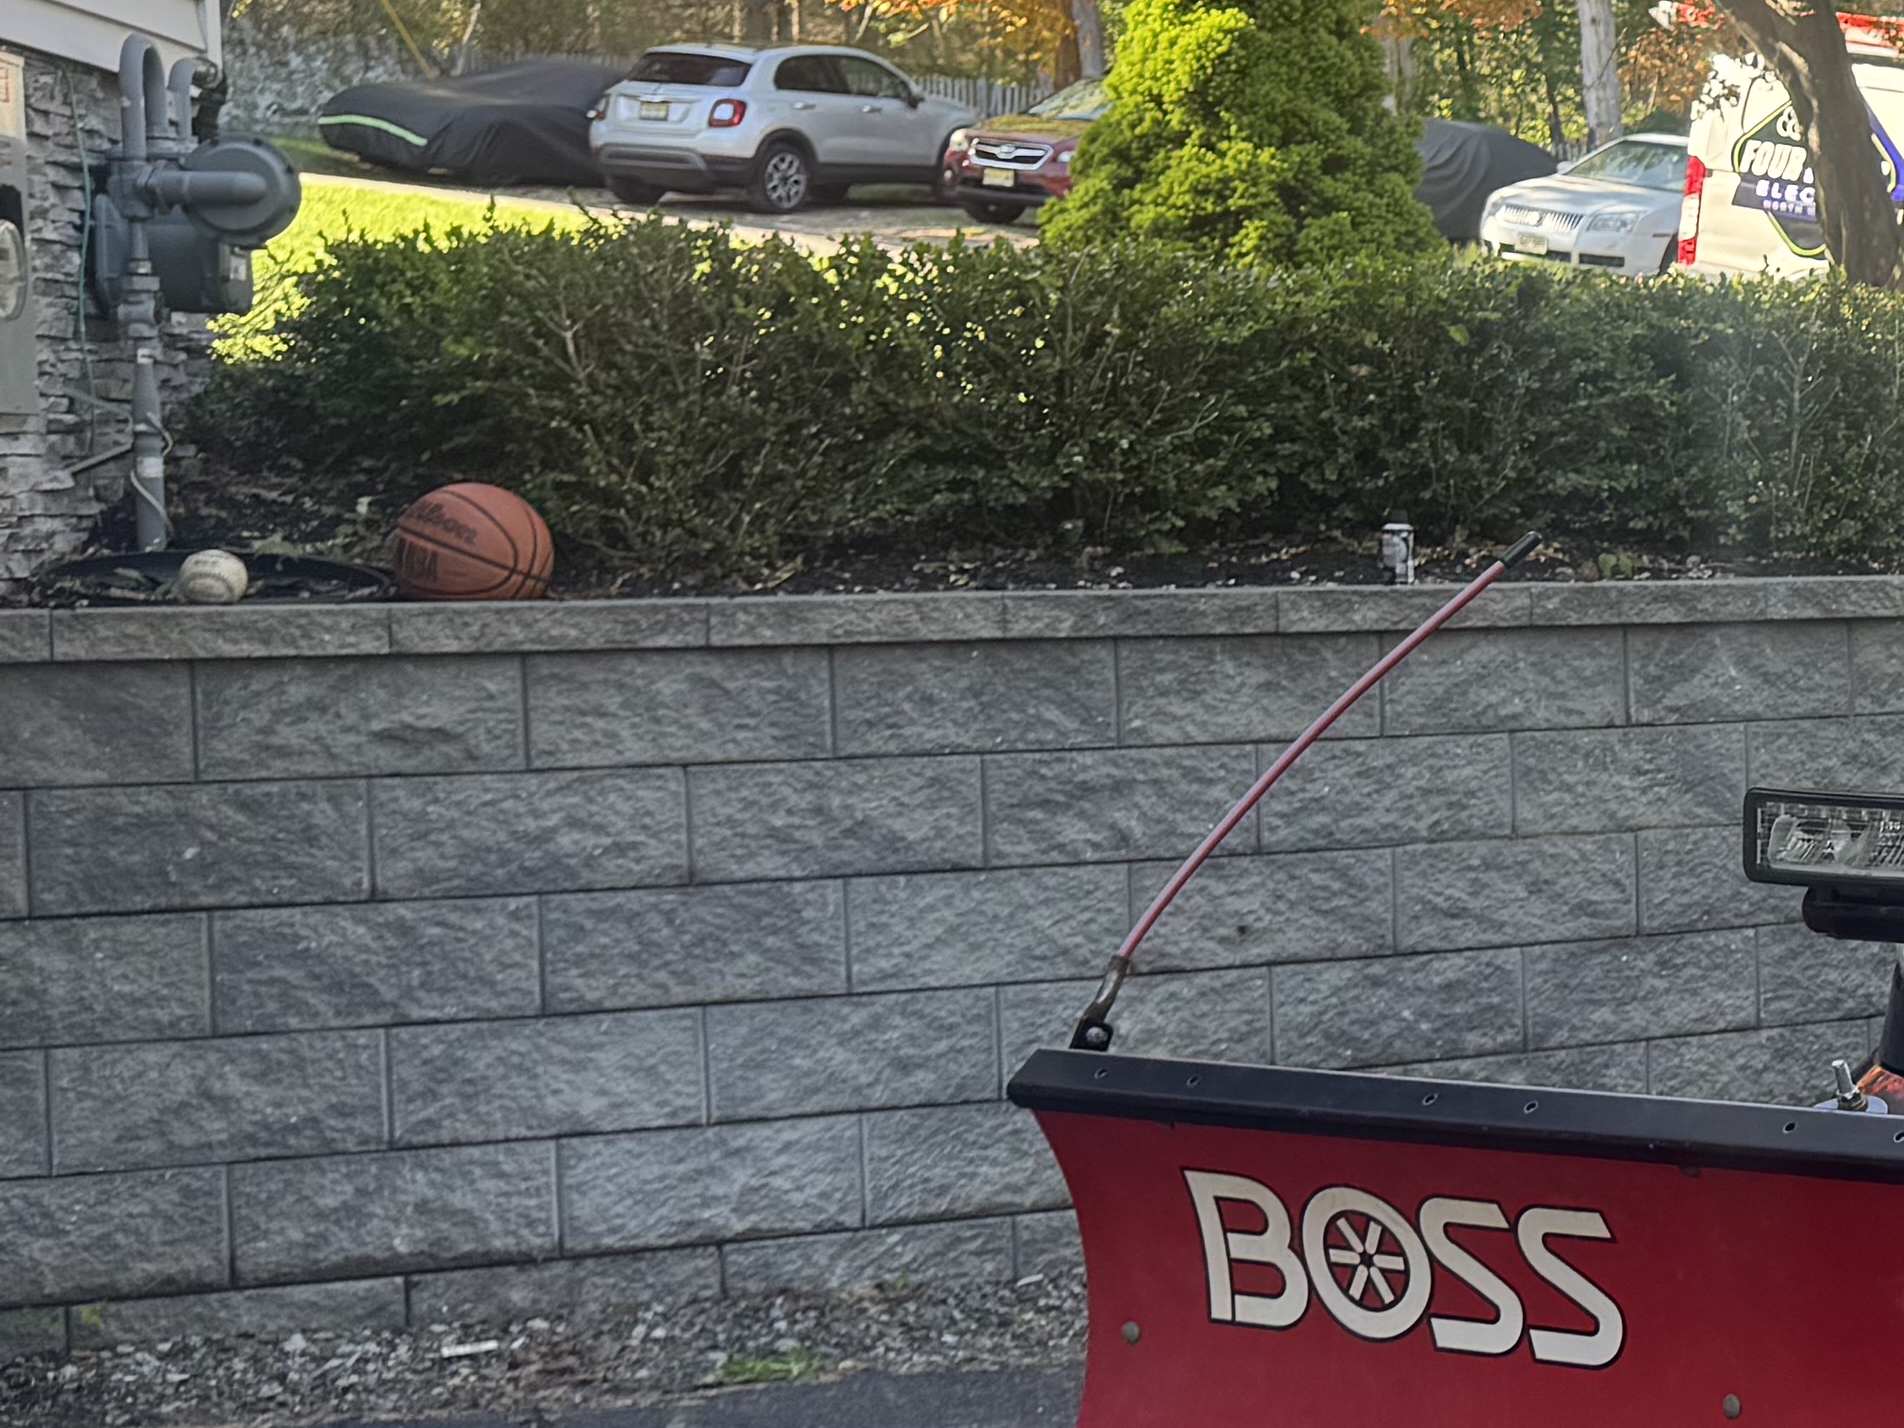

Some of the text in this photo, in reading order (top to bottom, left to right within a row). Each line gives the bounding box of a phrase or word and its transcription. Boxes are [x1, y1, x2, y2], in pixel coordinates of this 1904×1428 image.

[1740, 139, 1807, 181] FOUR
[1756, 180, 1815, 204] ELEC
[1179, 1167, 1626, 1370] BOSS
